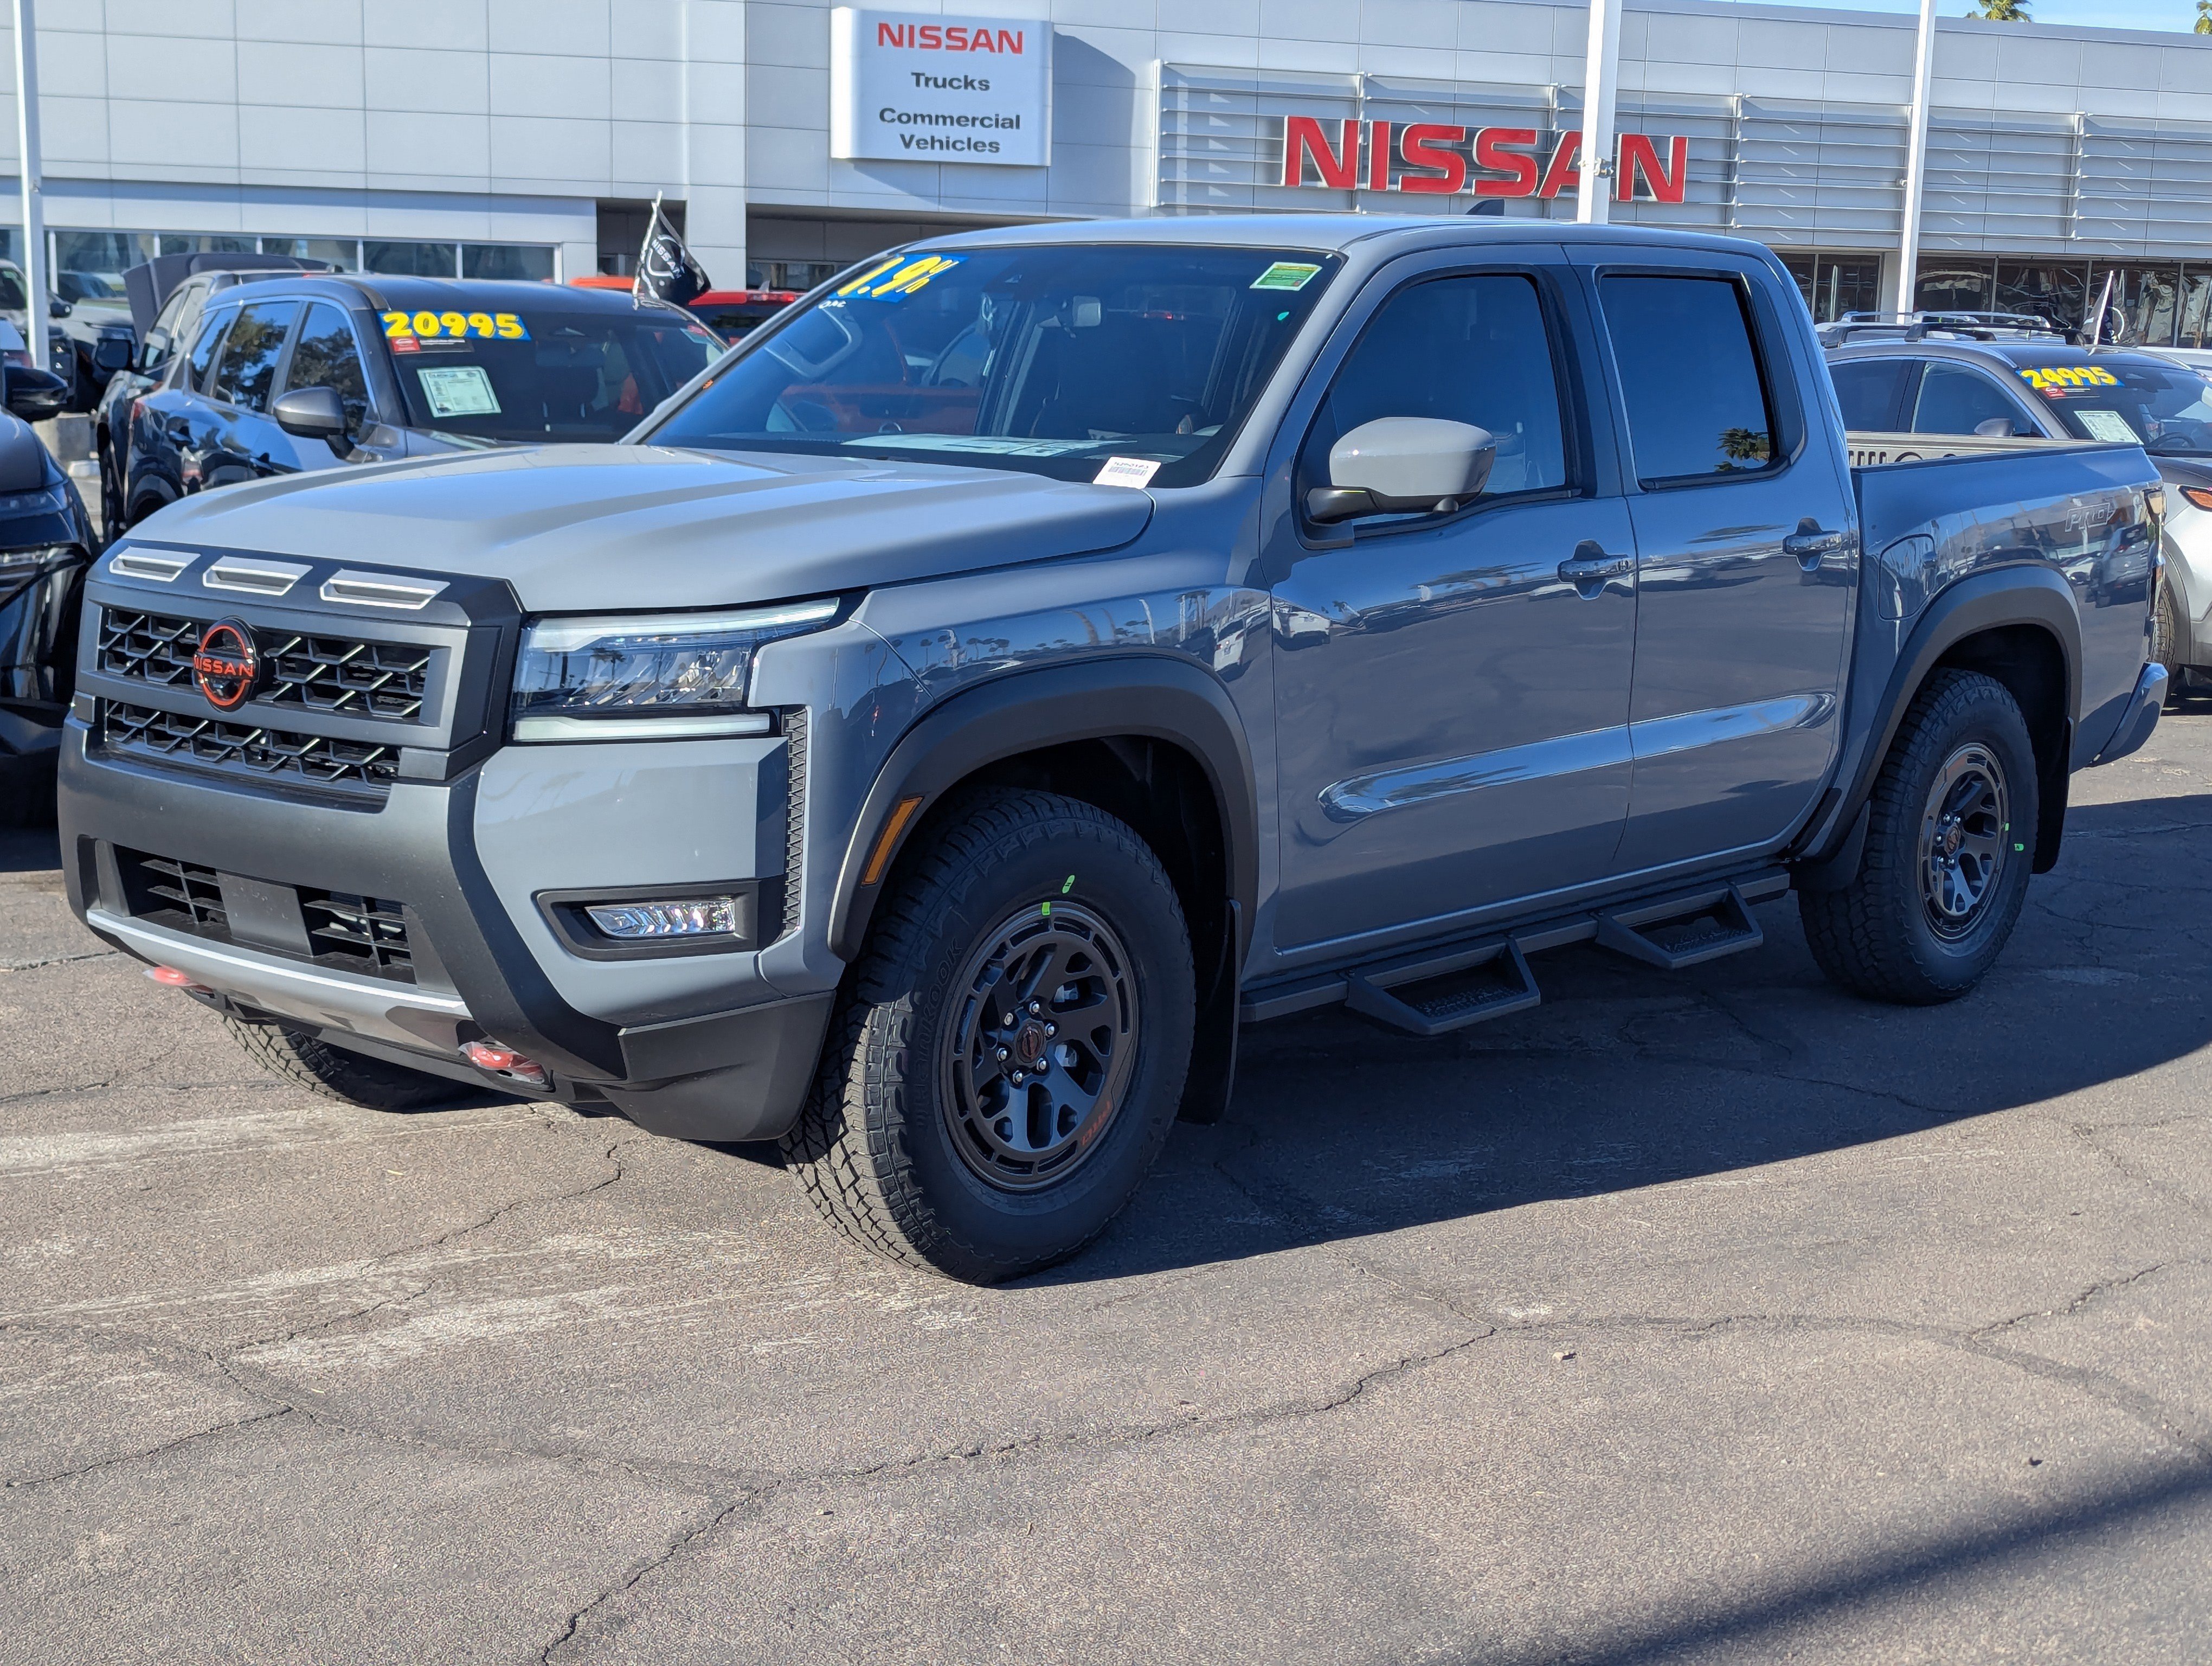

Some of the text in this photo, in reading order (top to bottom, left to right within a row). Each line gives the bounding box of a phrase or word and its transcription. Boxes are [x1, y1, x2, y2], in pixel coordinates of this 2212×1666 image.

[877, 22, 1023, 55] NISSAN
[911, 72, 991, 92] Trucks
[879, 107, 1020, 130] Commercial
[899, 133, 1001, 153] Vehicles
[383, 311, 525, 339] 20995
[2021, 366, 2117, 389] 24995
[193, 653, 254, 677] NISSAN
